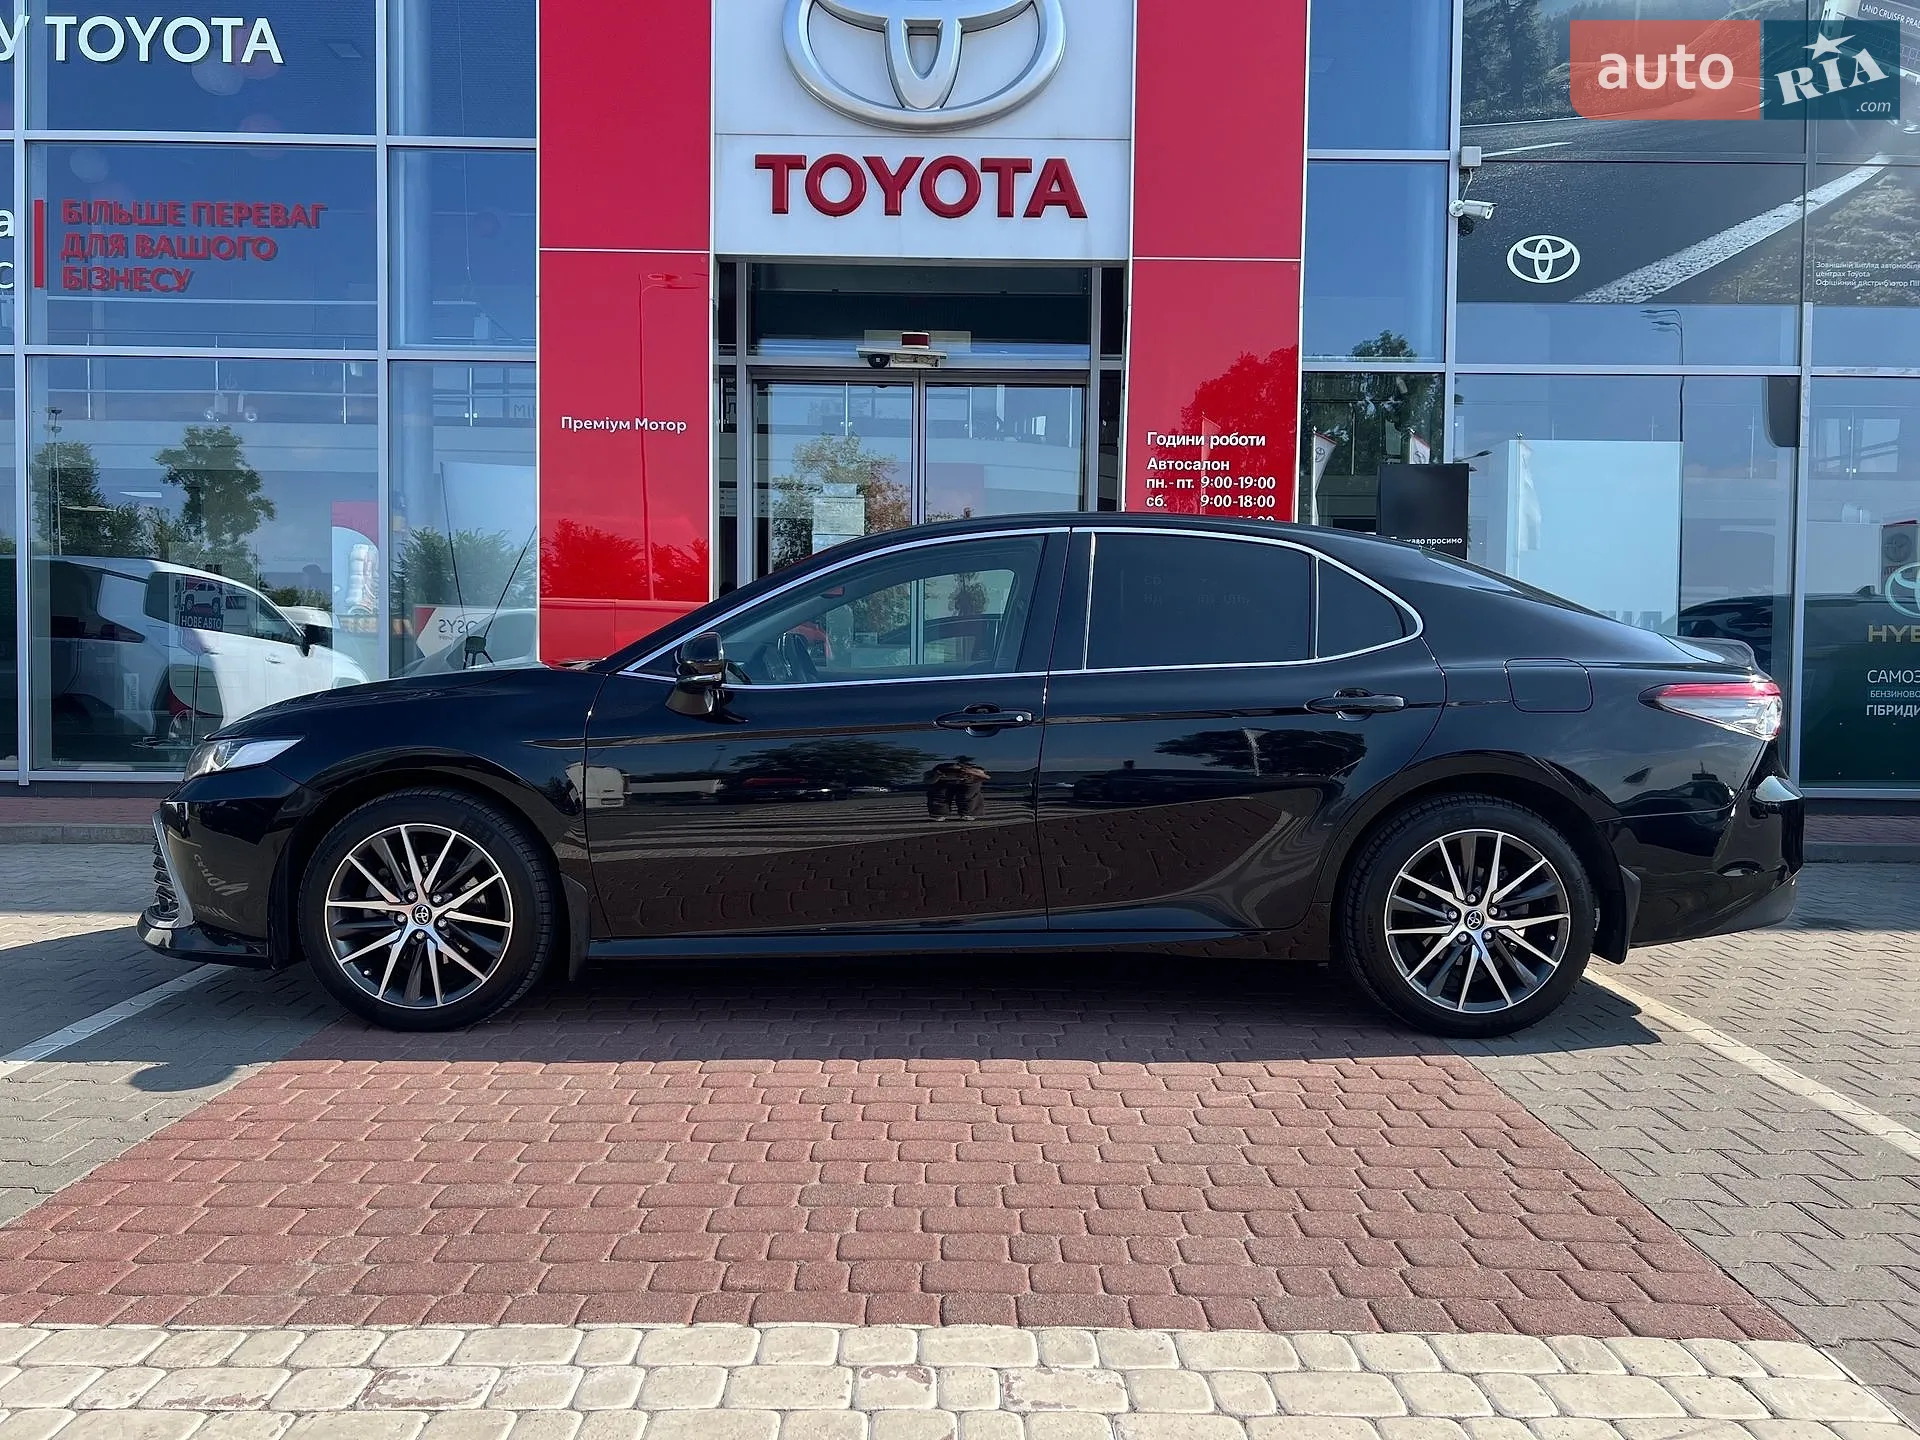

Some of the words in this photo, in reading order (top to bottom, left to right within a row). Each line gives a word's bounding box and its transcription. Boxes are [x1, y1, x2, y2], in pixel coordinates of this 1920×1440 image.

[1861, 3, 1878, 15] LAND
[45, 15, 284, 64] TOYOTA
[754, 153, 1088, 219] TOYOTA
[61, 199, 185, 226] БІЛЬШЕ
[192, 200, 328, 228] ПЕРЕВАГ
[60, 233, 126, 260] ДЛЯ
[135, 234, 278, 260] ВАШОГО
[62, 266, 192, 292] БІЗНЕСУ
[1847, 270, 1871, 278] Toyota
[560, 416, 631, 433] Преміум
[635, 417, 688, 435] Мотор
[1147, 431, 1205, 448] Години
[1209, 432, 1266, 449] роботи
[1147, 457, 1230, 471] Автосалон
[1200, 476, 1276, 489] 9:00-19:00
[1146, 495, 1168, 507] сб.
[1200, 494, 1276, 508] 9:00-18:00
[1426, 537, 1463, 546] просимо
[181, 615, 202, 627] НОВЕ
[203, 616, 222, 629] АВТО
